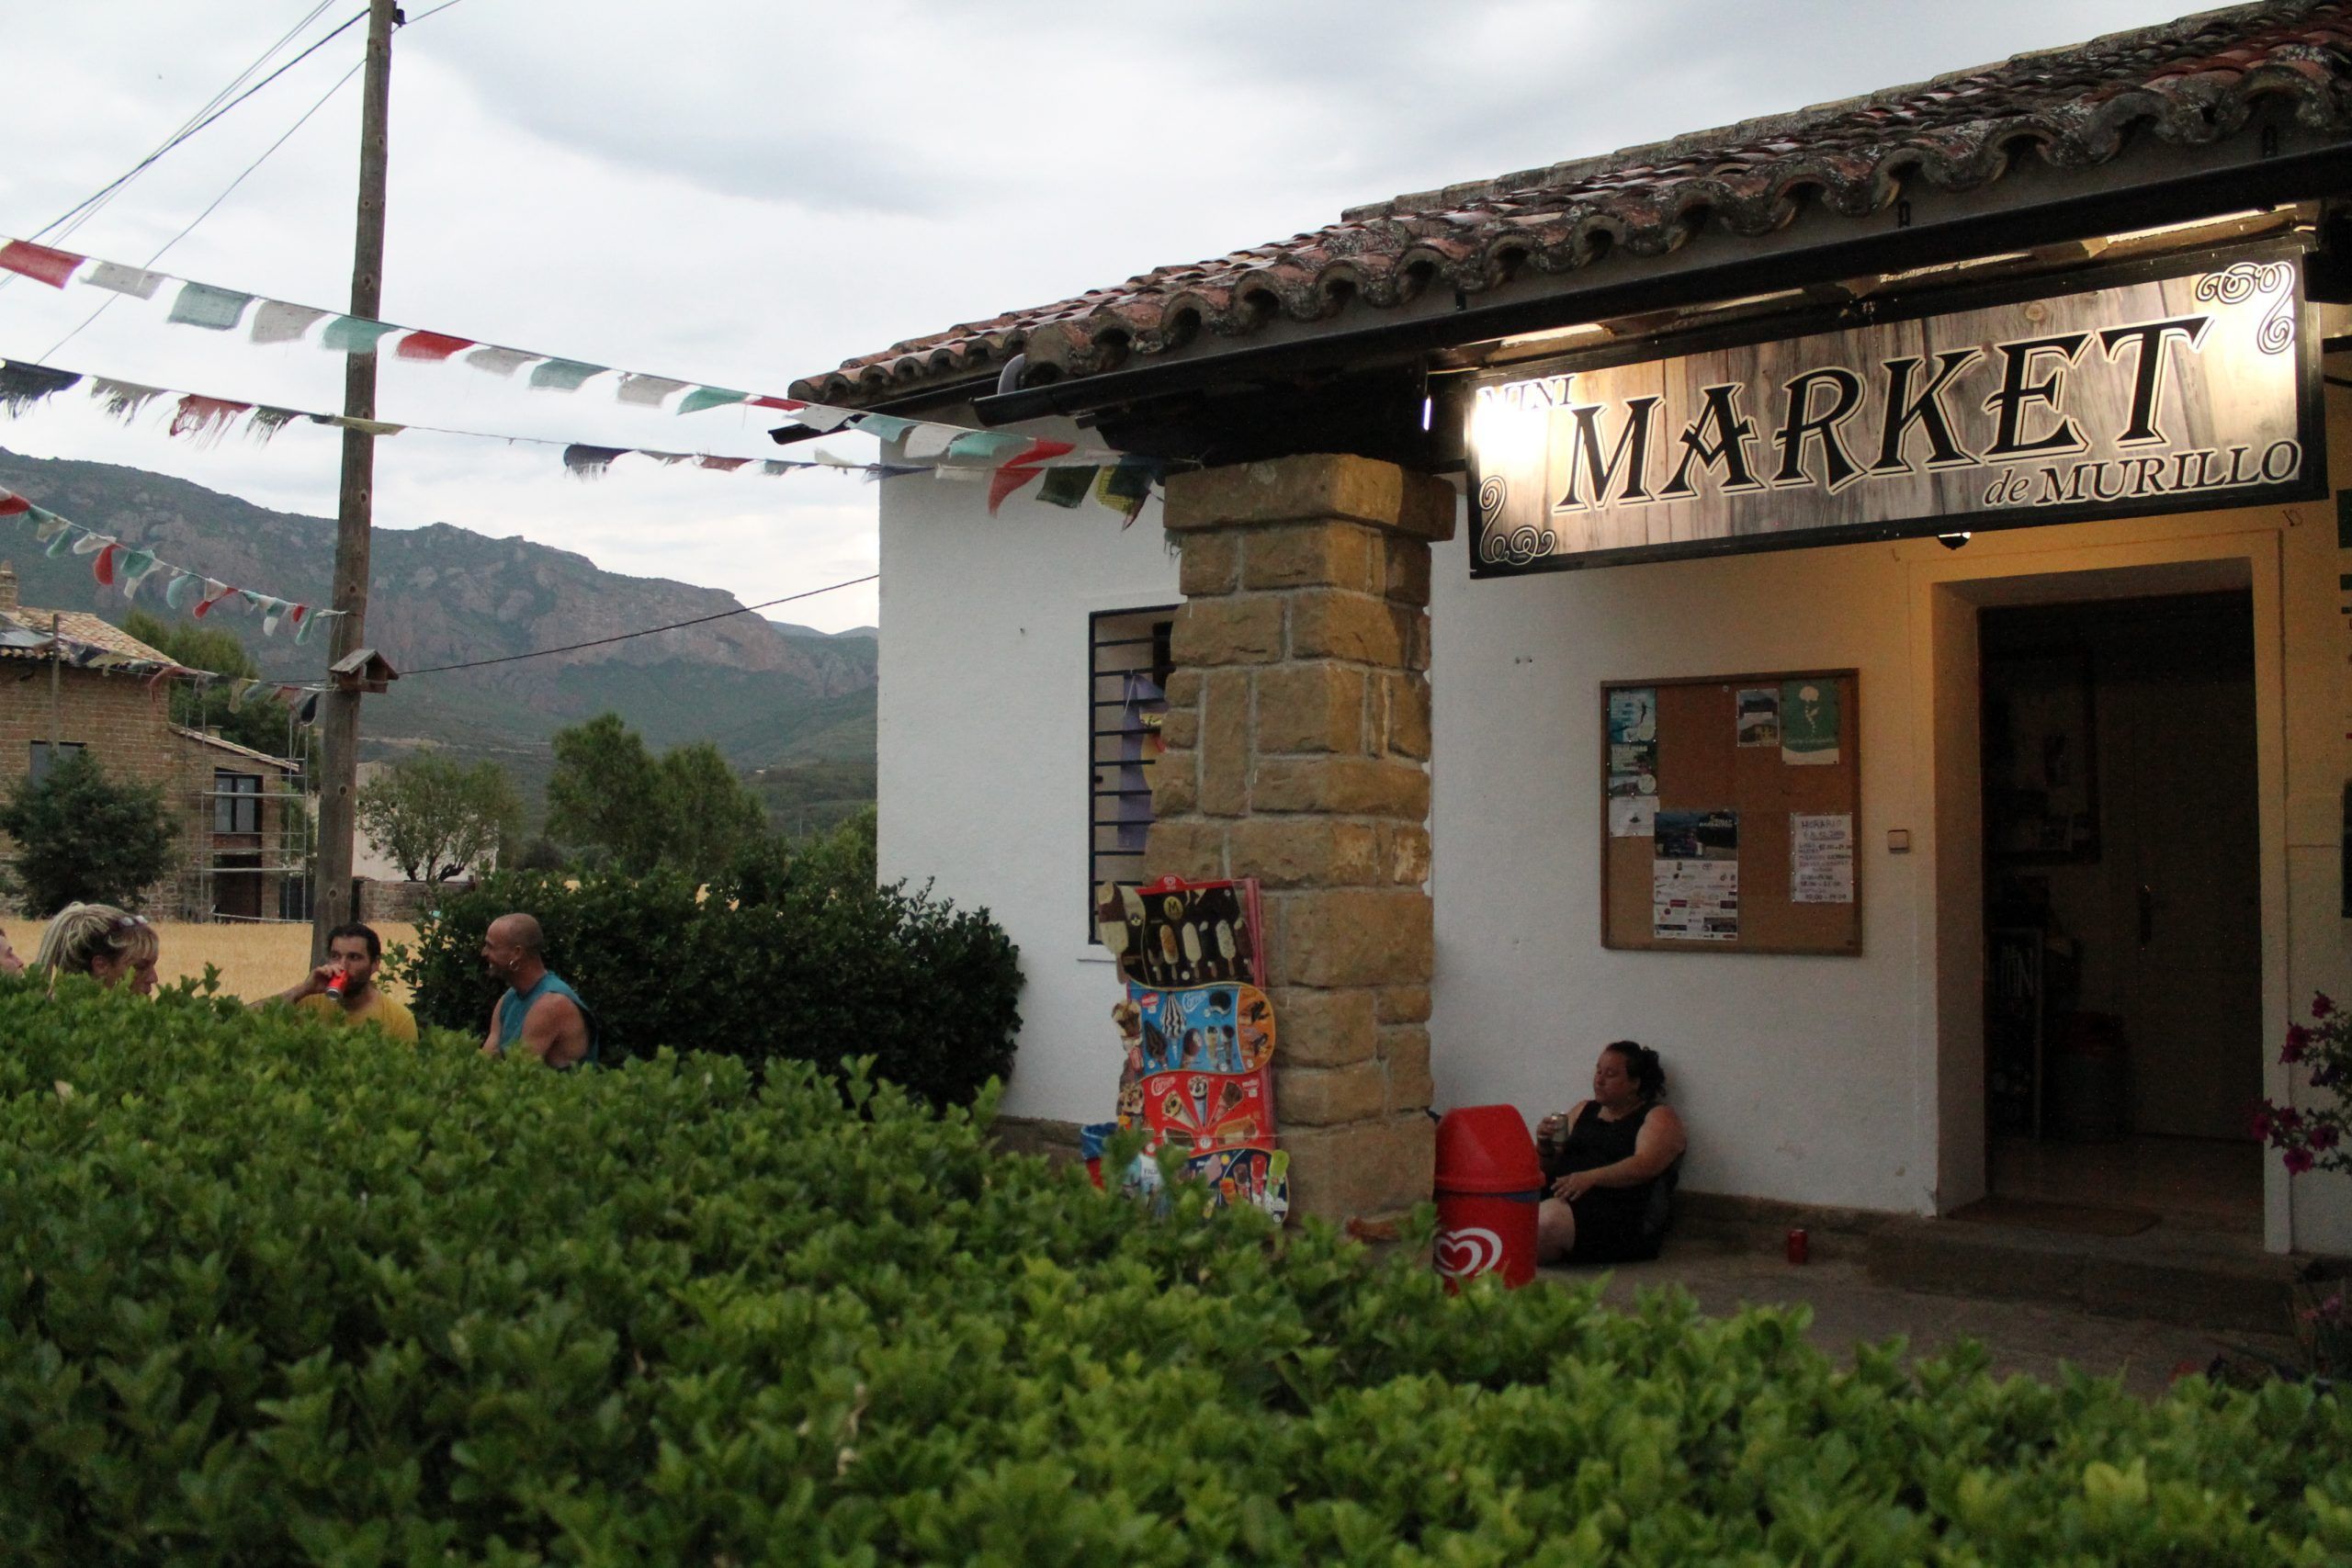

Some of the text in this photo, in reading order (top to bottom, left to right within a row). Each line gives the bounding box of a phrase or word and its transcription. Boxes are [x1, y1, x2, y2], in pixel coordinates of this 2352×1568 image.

[1553, 314, 2216, 513] MARKET
[1984, 441, 2297, 504] de MURILLO
